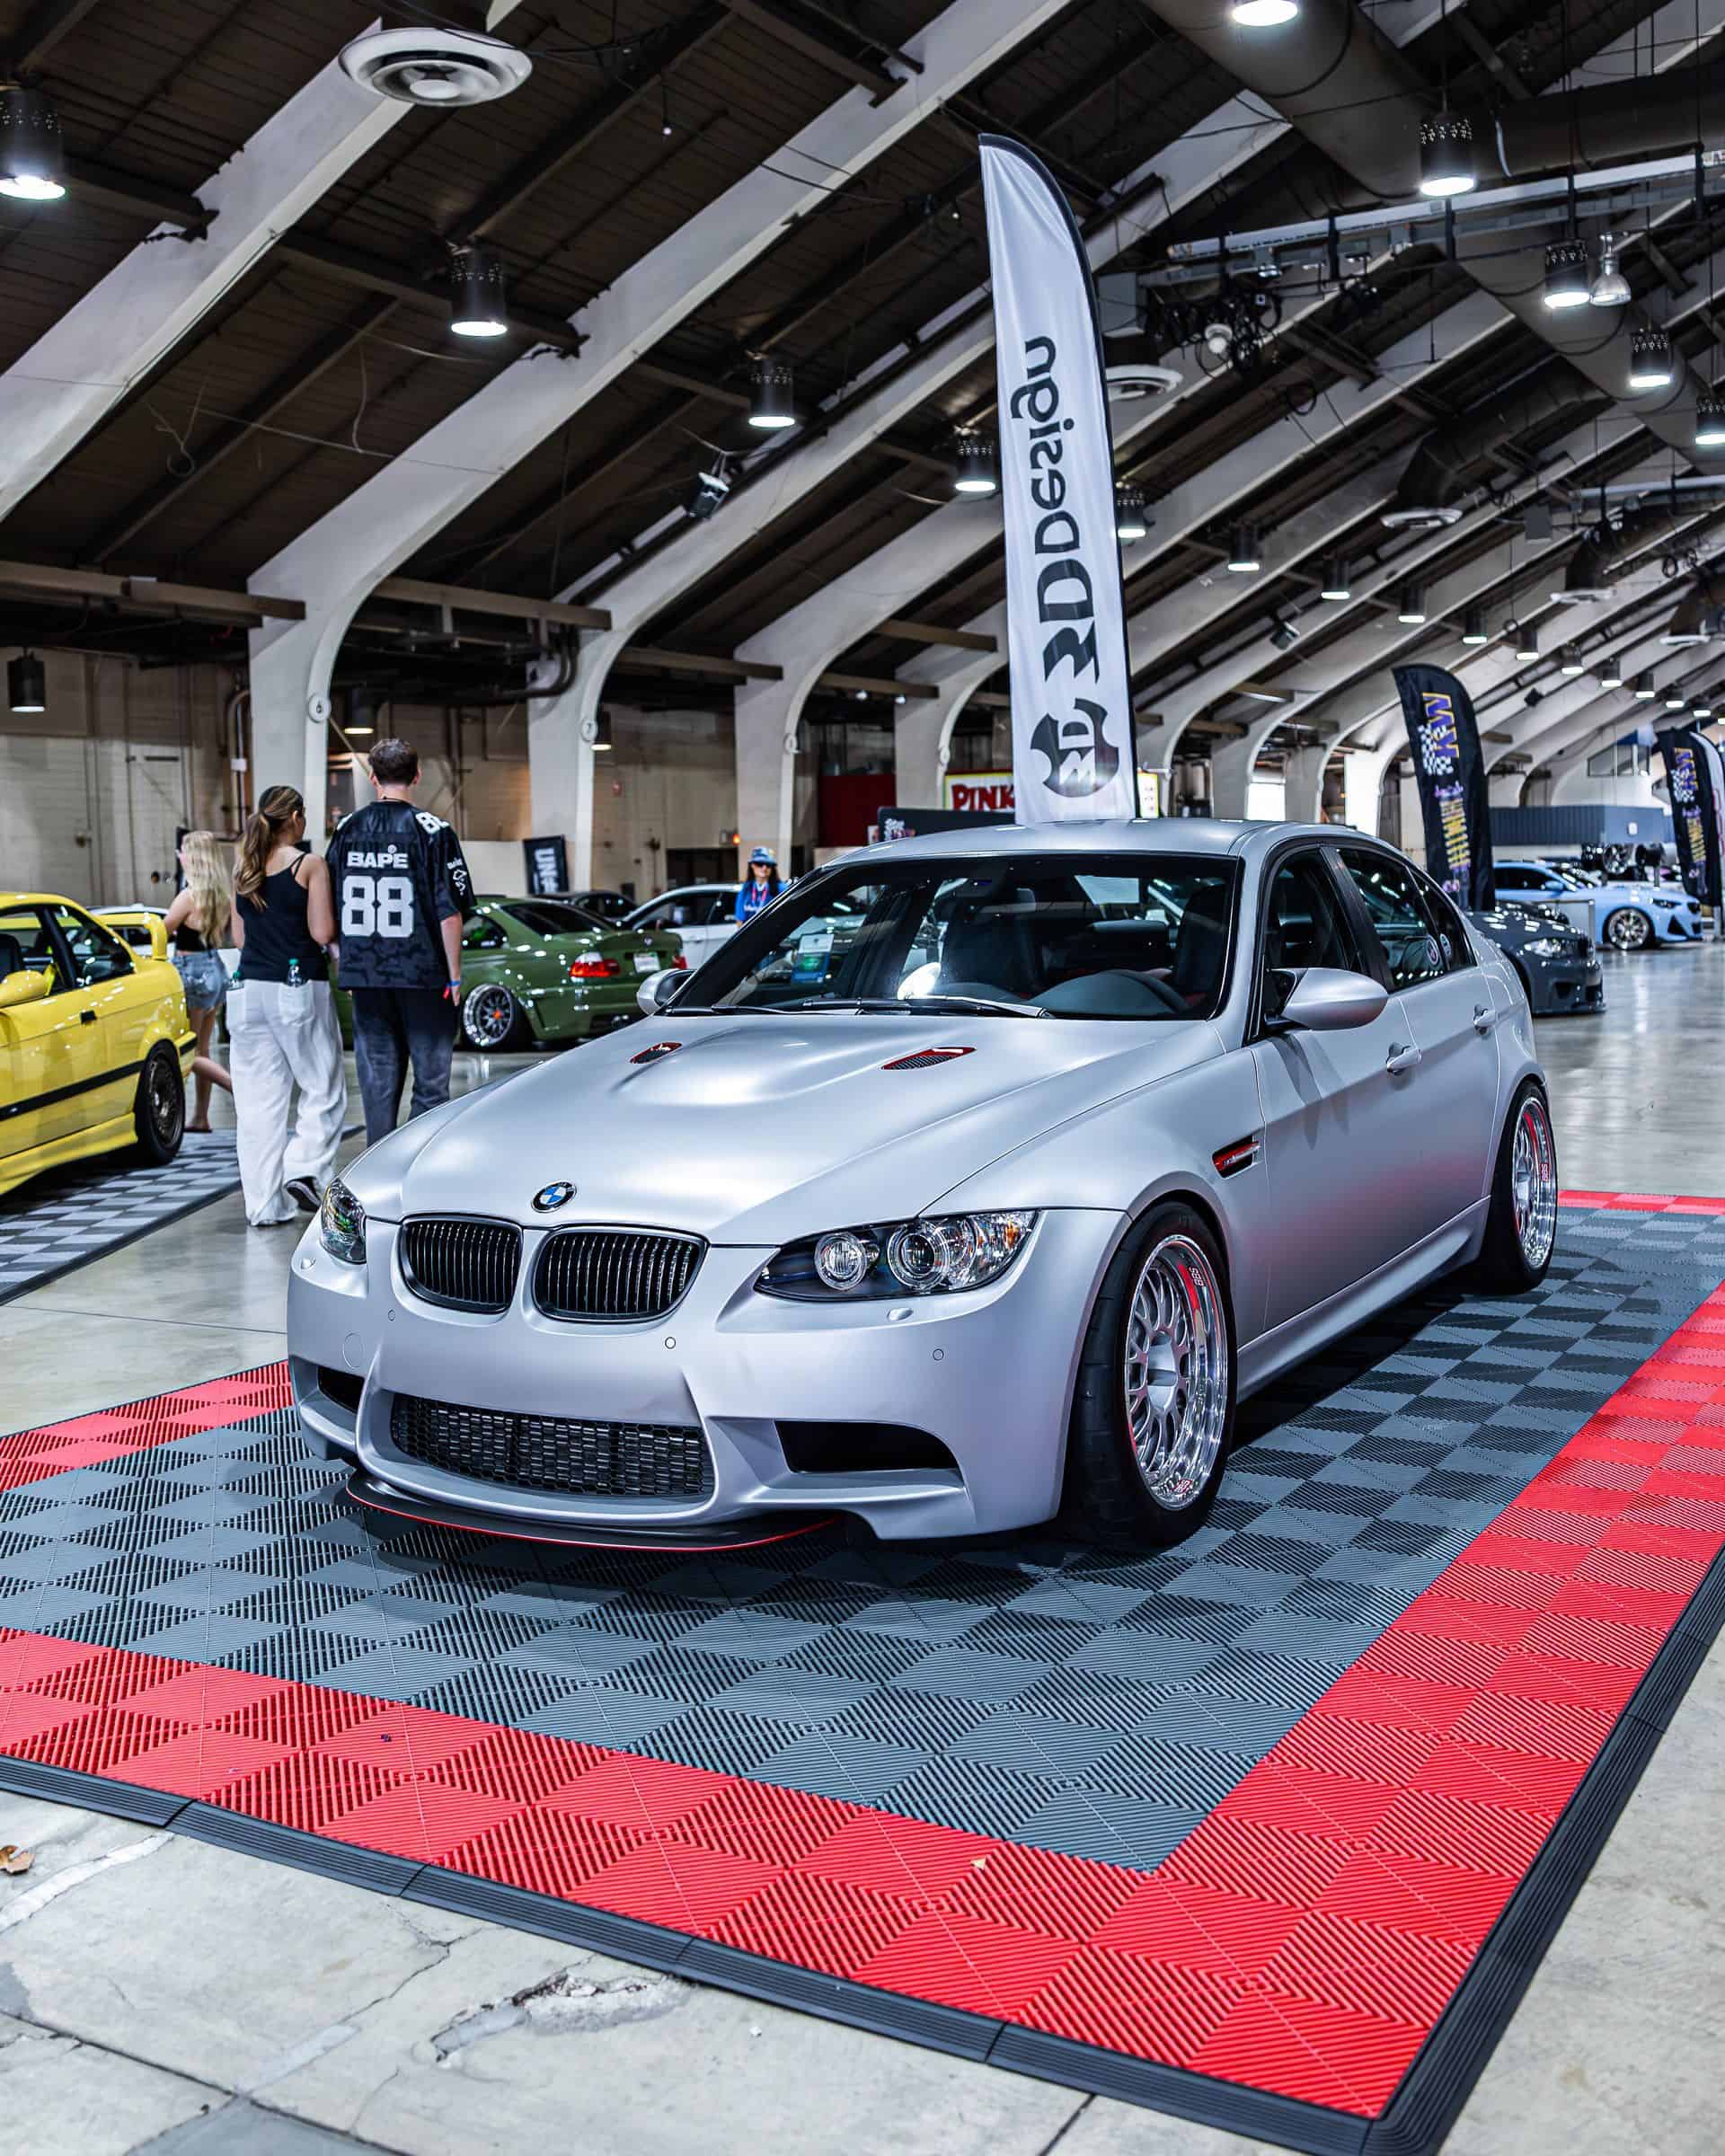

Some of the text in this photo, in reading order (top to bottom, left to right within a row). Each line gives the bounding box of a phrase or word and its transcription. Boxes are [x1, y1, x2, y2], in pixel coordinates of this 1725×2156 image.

[347, 852, 409, 869] BAPE
[342, 876, 413, 937] 88
[1189, 1267, 1204, 1286] BBS
